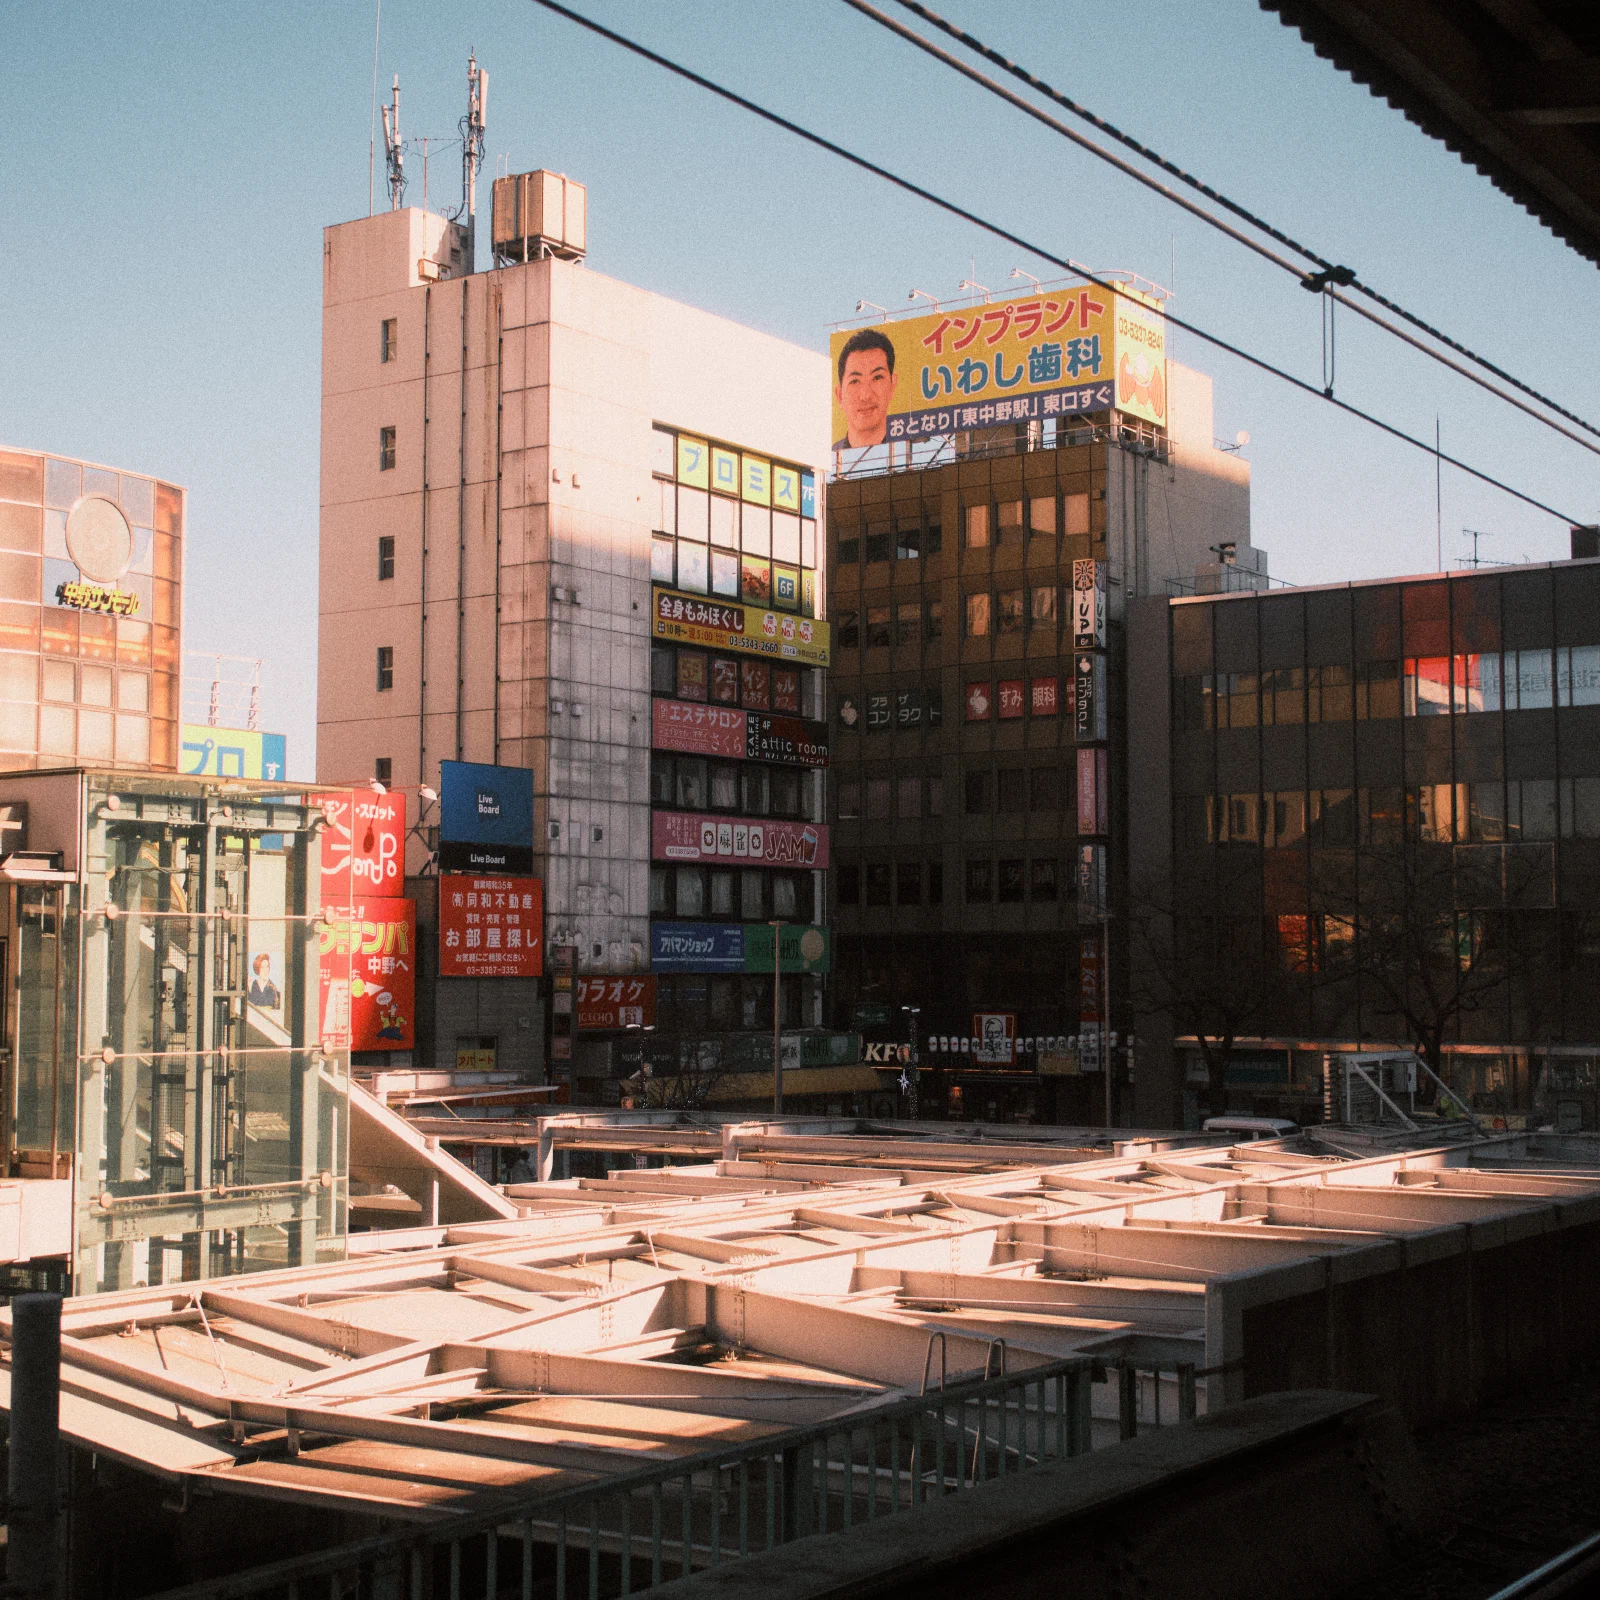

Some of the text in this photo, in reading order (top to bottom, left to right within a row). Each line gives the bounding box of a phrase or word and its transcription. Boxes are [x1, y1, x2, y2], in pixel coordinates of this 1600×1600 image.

[922, 291, 1105, 357] インプラント
[920, 334, 1103, 400] いわし歯科
[684, 446, 793, 501] プロミス
[779, 579, 793, 597] 6F
[659, 597, 743, 631] 全身もみほぐし
[729, 635, 778, 654] 03-5343-2660
[1078, 677, 1087, 733] コンタクト
[669, 705, 742, 729] エステサロン
[762, 720, 771, 730] 4F
[868, 706, 941, 725] コンタクト
[762, 736, 828, 756] attic room
[478, 794, 493, 804] Live
[478, 804, 500, 815] Board
[765, 832, 805, 863] JAM
[470, 853, 506, 864] Live Board
[445, 927, 538, 948] お部屋探し
[660, 936, 714, 953] アパマンショップ
[368, 956, 409, 975] 中野へ
[466, 966, 519, 974] 03-3387-3351
[577, 979, 645, 1003] カラオケ
